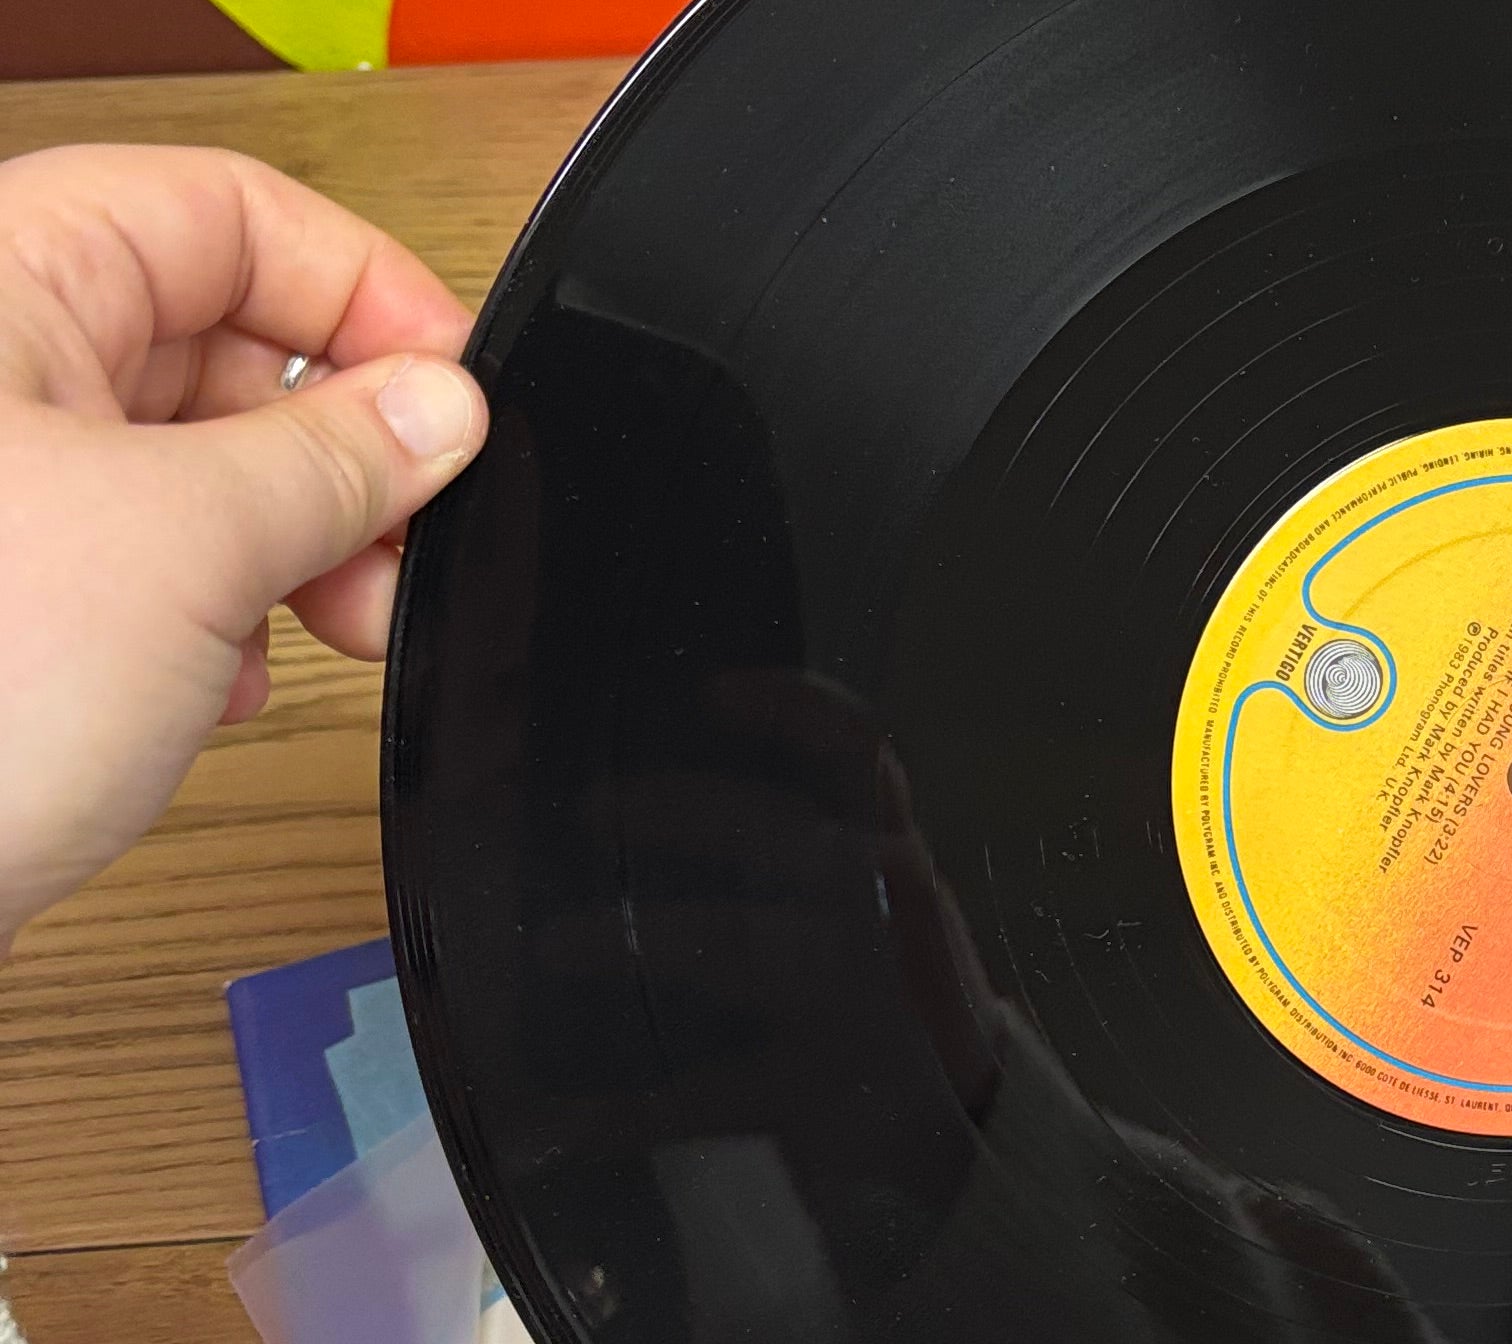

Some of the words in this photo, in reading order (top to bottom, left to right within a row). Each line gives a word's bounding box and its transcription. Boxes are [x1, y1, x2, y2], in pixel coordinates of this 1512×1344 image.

[1387, 466, 1418, 487] PUBLIC
[1330, 480, 1387, 522] PERFORMANCE
[1312, 518, 1331, 536] AND
[1263, 532, 1315, 590] BROADCASTING
[1242, 601, 1260, 623] THIS
[1255, 588, 1268, 602] OF
[1224, 624, 1247, 659] RECORD
[1275, 623, 1318, 682] VERTIGO
[1452, 626, 1500, 700] Produced
[1482, 643, 1511, 686] titles
[1408, 672, 1455, 743] Phonogram
[1438, 700, 1459, 721] by
[1451, 685, 1487, 738] written
[1496, 688, 1509, 698] I
[1476, 698, 1504, 736] HAD
[1199, 719, 1214, 791] MANUFACTURED
[1416, 722, 1447, 762] Mark
[1437, 741, 1458, 762] by
[1453, 741, 1482, 777] YOU
[1200, 794, 1208, 807] BY
[1378, 765, 1423, 833] Knopfler
[1414, 764, 1446, 805] Mark
[1452, 753, 1496, 818] LOVERS
[1200, 809, 1215, 858] POLYGRAM
[1378, 807, 1423, 875] Knopfler
[1423, 817, 1460, 866] (3:22)
[1214, 880, 1227, 900] AND
[1220, 900, 1252, 956] DISTRIBUTED
[1449, 924, 1479, 964] VEP
[1247, 954, 1260, 968] BY
[1255, 966, 1290, 1009] POLYGRAM
[1420, 968, 1452, 1009] 314
[1288, 1007, 1339, 1053] DISTRIBUTION
[1354, 1059, 1377, 1078] 6000
[1398, 1081, 1410, 1093] DE
